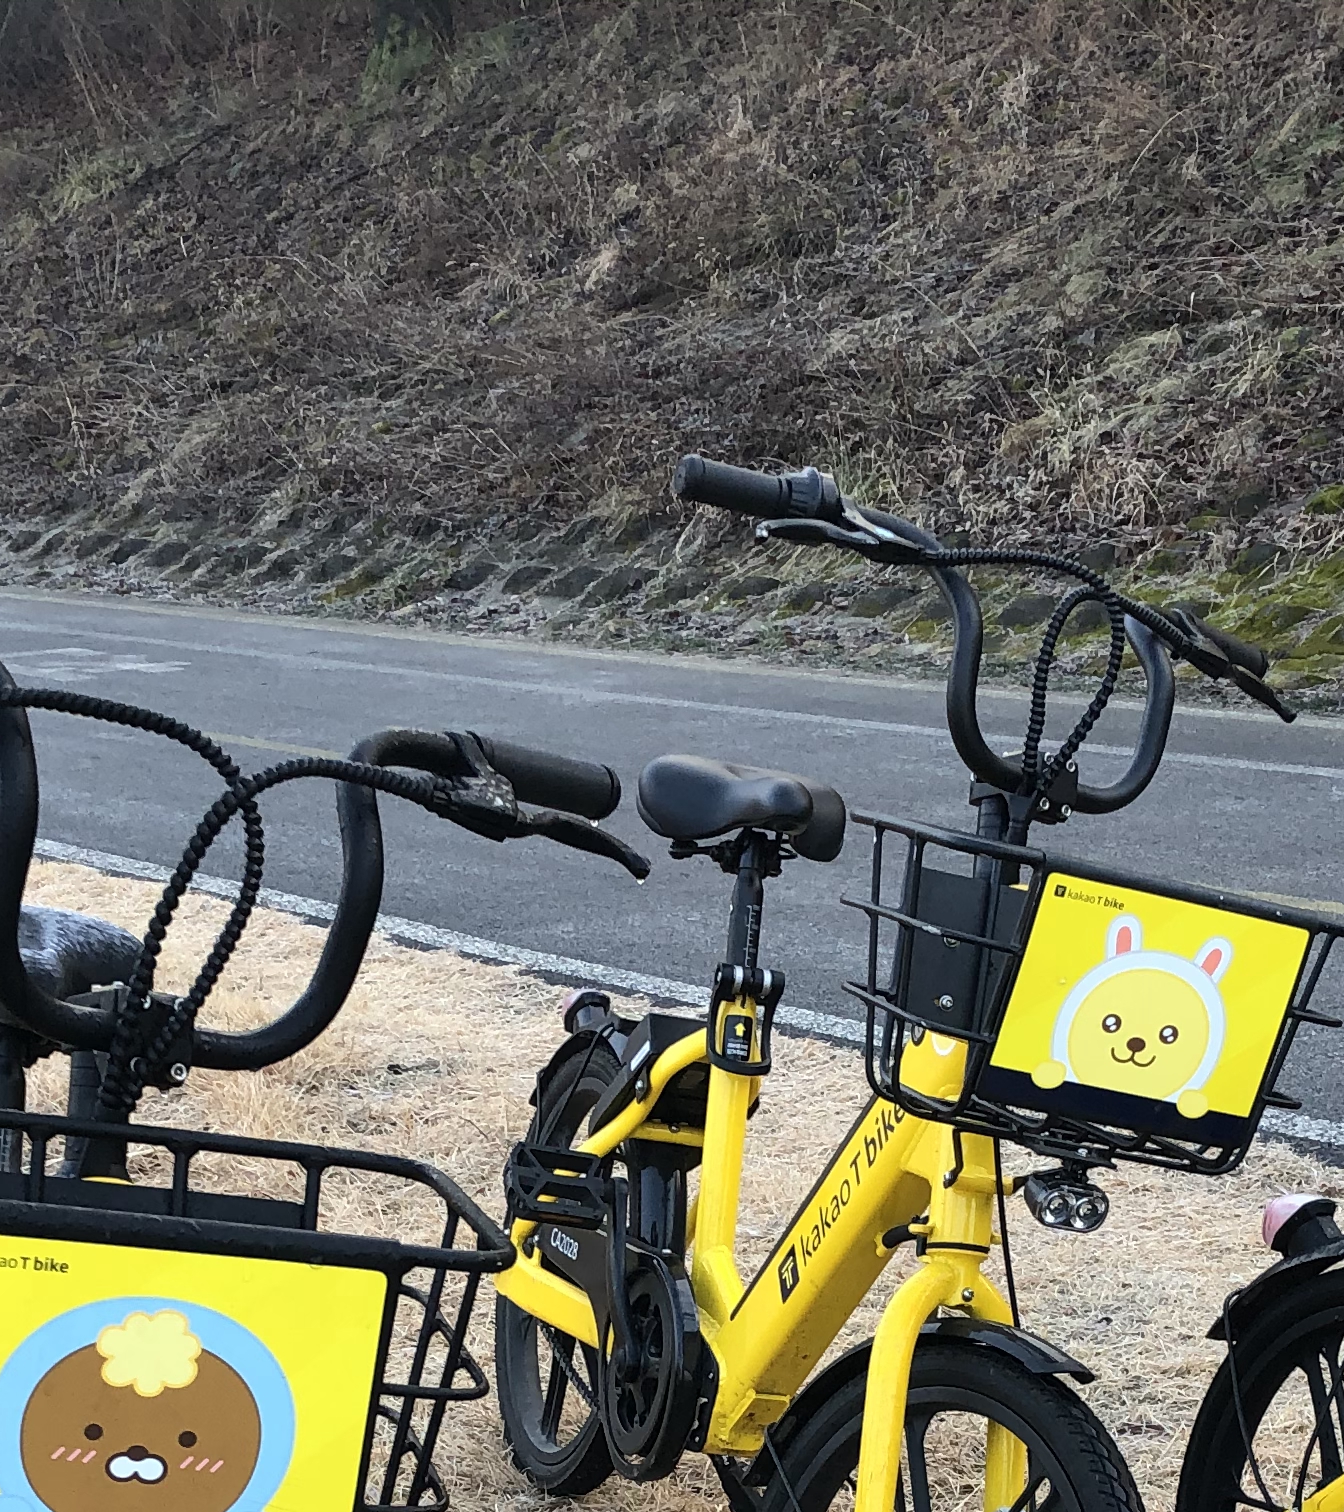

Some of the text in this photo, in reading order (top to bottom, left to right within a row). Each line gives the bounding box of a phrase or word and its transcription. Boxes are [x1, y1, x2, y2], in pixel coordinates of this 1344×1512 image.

[1067, 889, 1095, 904] kakao
[1097, 896, 1103, 906] T
[1104, 897, 1125, 911] bike
[800, 1179, 851, 1267] kakao
[850, 1150, 861, 1187] T
[864, 1102, 907, 1168] bike
[550, 1227, 579, 1260] CA2028
[20, 1256, 31, 1270] T
[33, 1256, 70, 1274] bike
